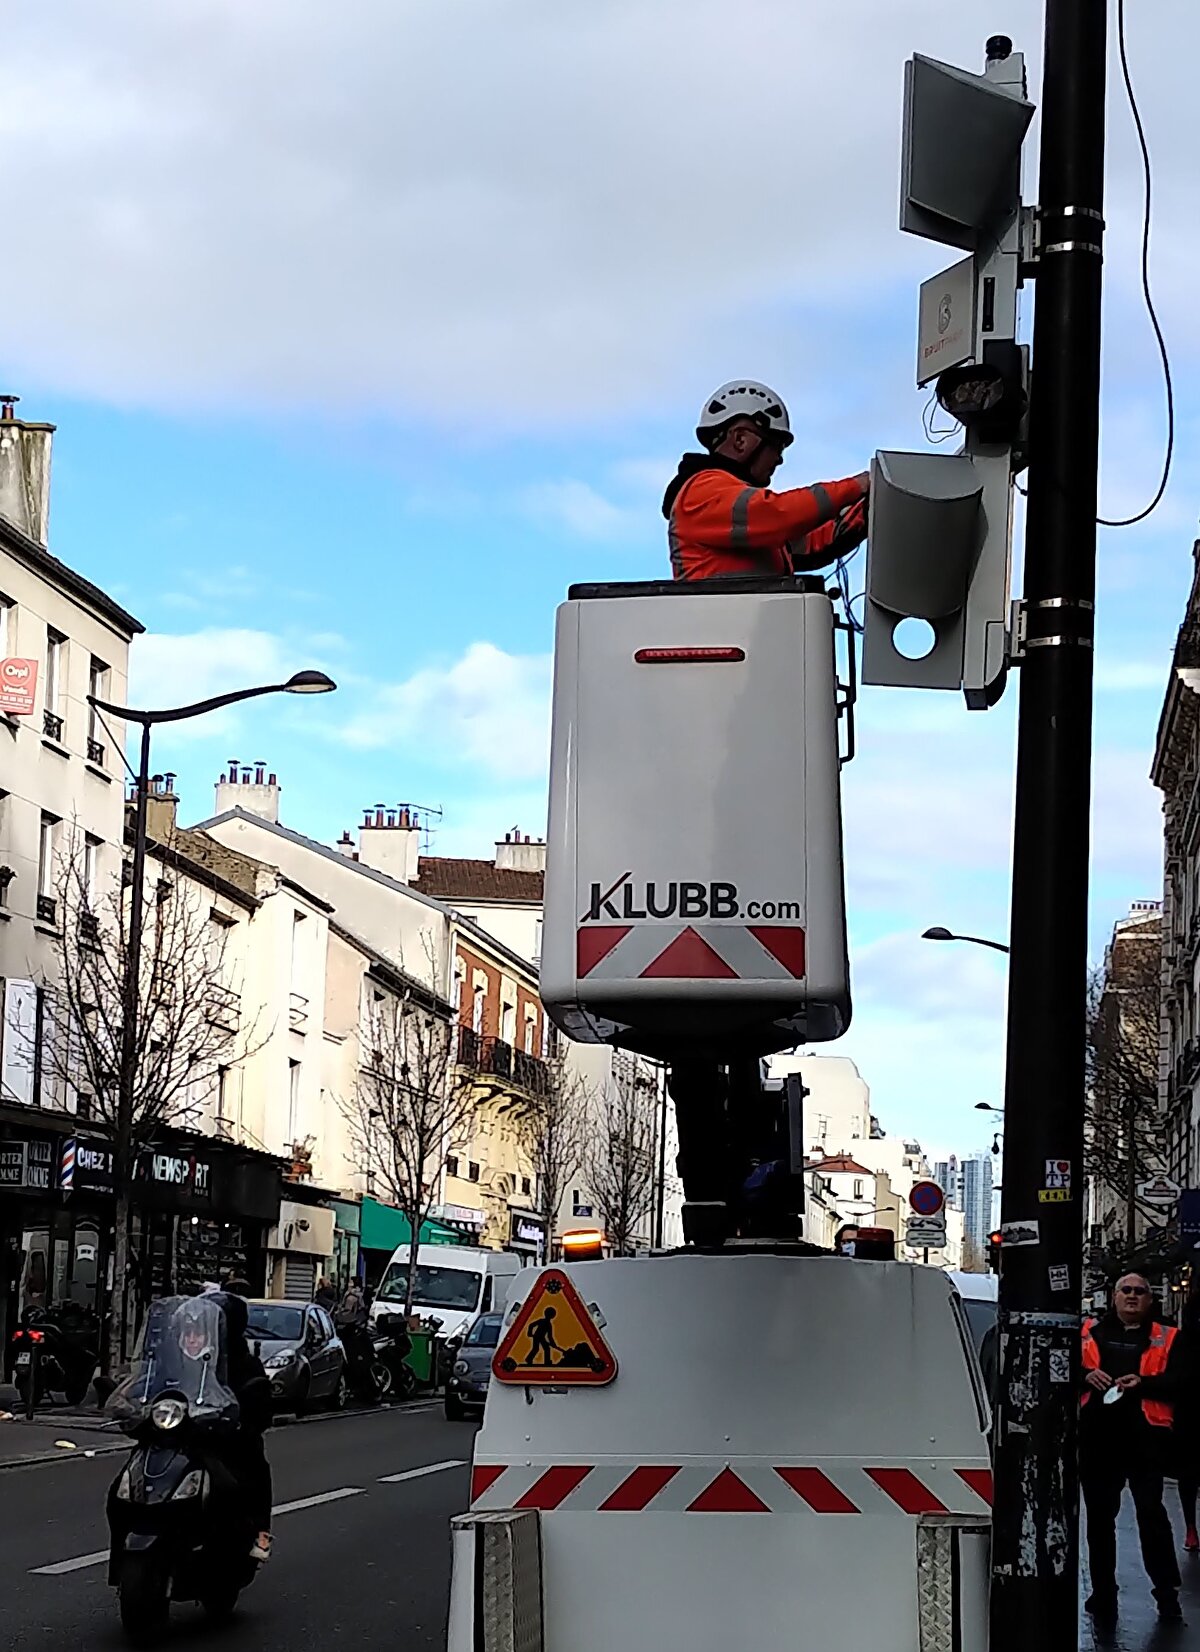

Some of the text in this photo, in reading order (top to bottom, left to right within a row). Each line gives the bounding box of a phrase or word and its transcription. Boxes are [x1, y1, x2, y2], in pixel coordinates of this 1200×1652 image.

[580, 872, 800, 922] KLUBB.com
[77, 1147, 105, 1170] CHEZ
[1046, 1174, 1070, 1187] TP
